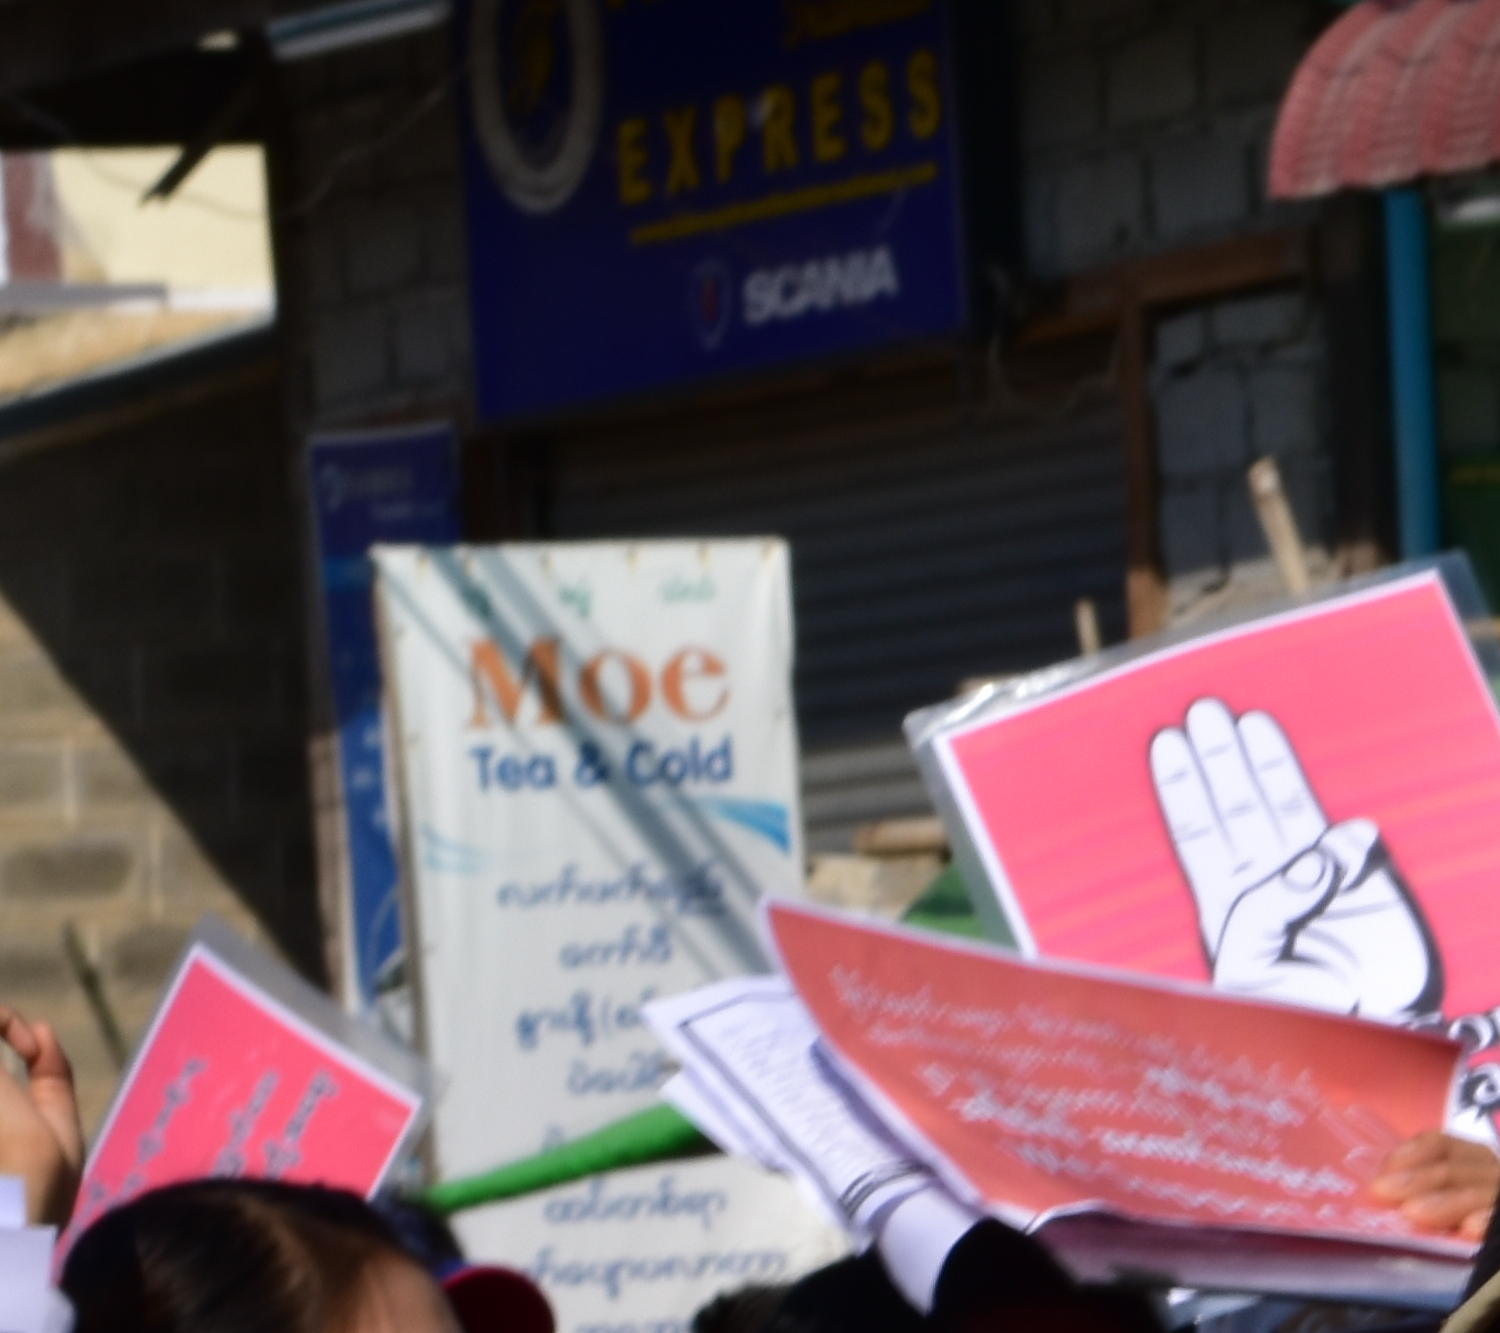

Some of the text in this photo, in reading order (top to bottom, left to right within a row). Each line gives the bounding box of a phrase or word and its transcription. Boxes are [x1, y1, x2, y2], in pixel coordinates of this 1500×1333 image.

[615, 48, 943, 207] EXPRESS
[743, 245, 898, 326] SCANIA
[467, 632, 733, 729] Moe
[471, 734, 735, 794] Tea & Cold
